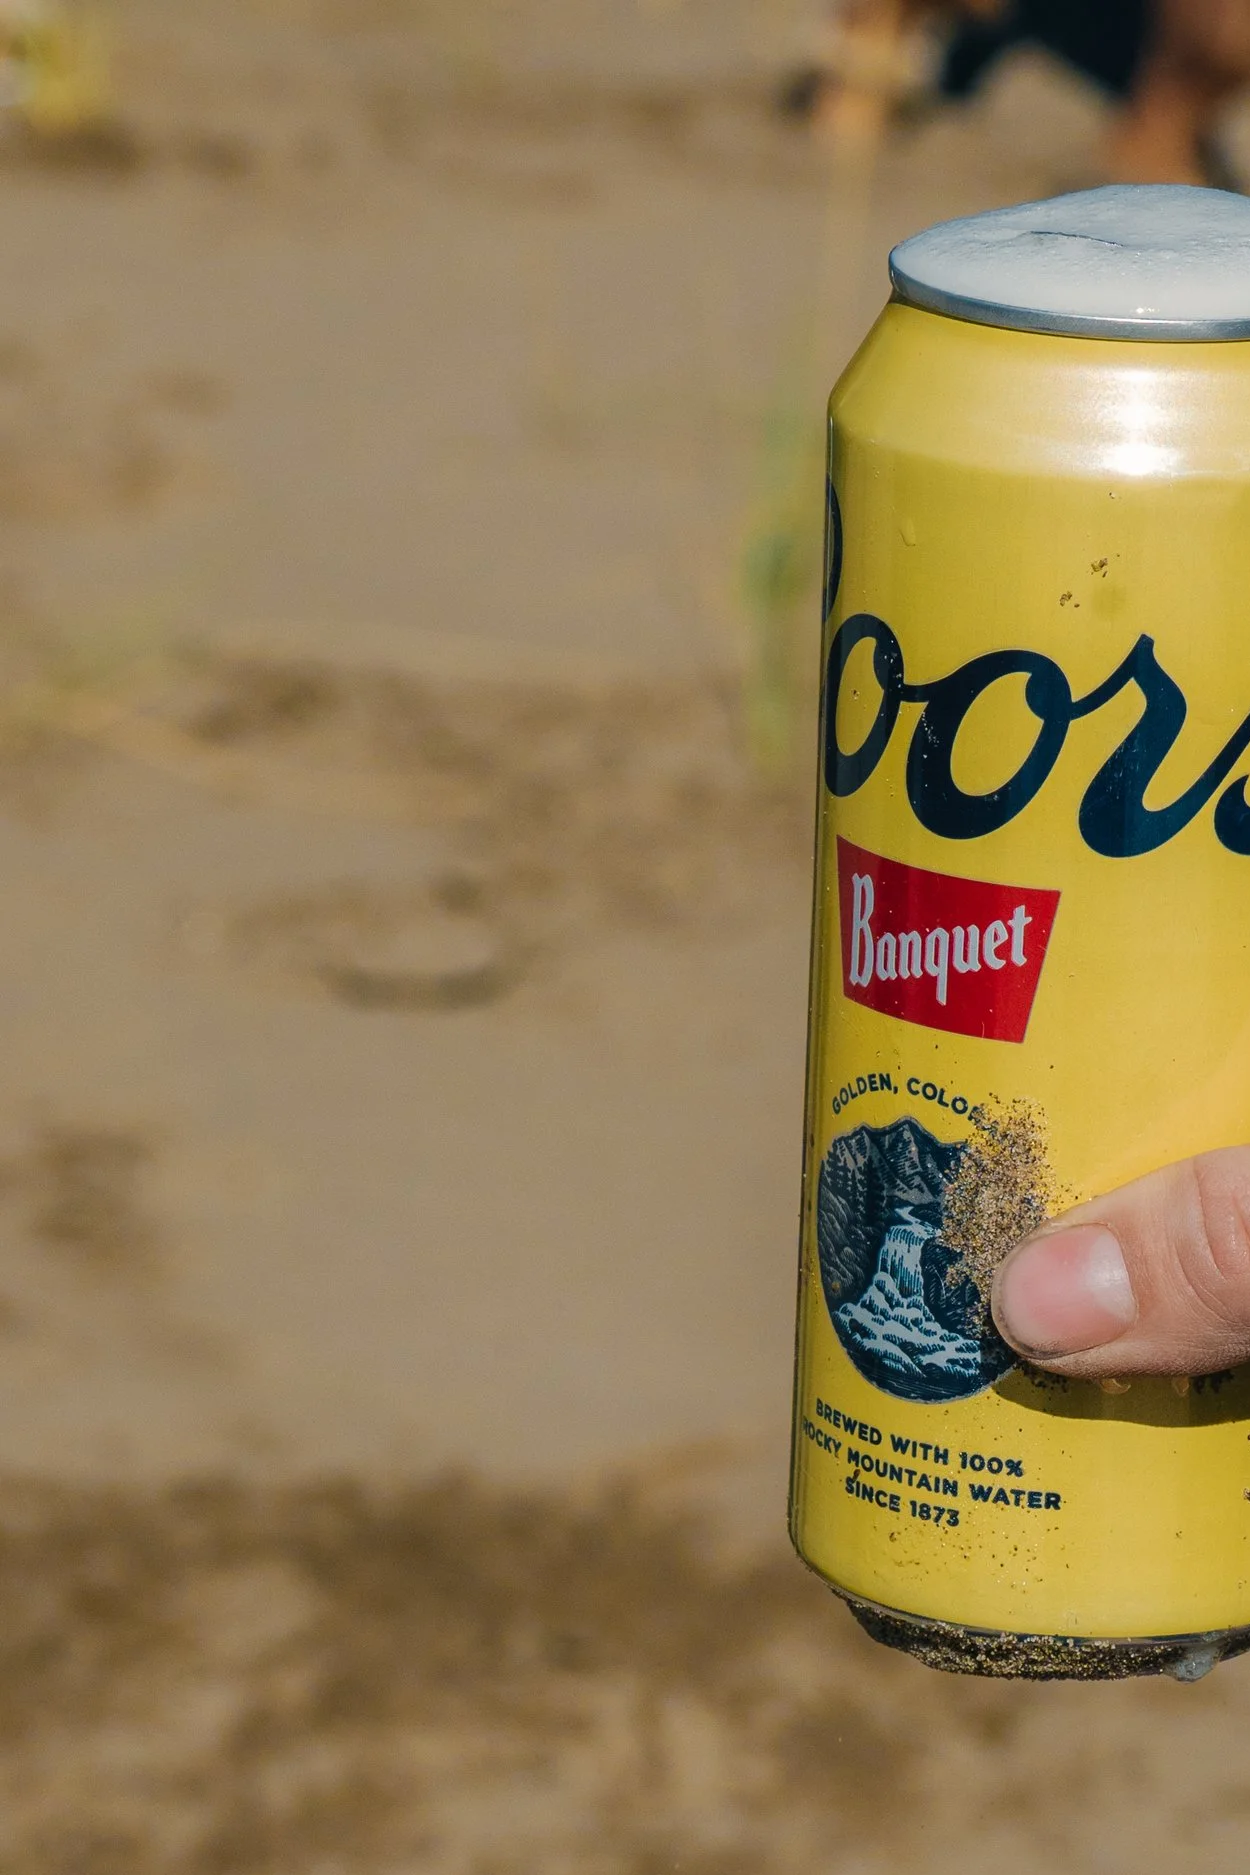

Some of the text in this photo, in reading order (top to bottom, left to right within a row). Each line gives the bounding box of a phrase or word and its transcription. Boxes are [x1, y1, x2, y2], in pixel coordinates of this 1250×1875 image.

[849, 872, 1033, 1006] Banquet
[832, 1072, 898, 1115] GOLDEN,
[802, 1414, 1062, 1511] ROCKY MOUNTAIN WATER
[816, 1397, 1024, 1478] BREWED WITH 100%
[845, 1475, 960, 1527] SINCE 1873
